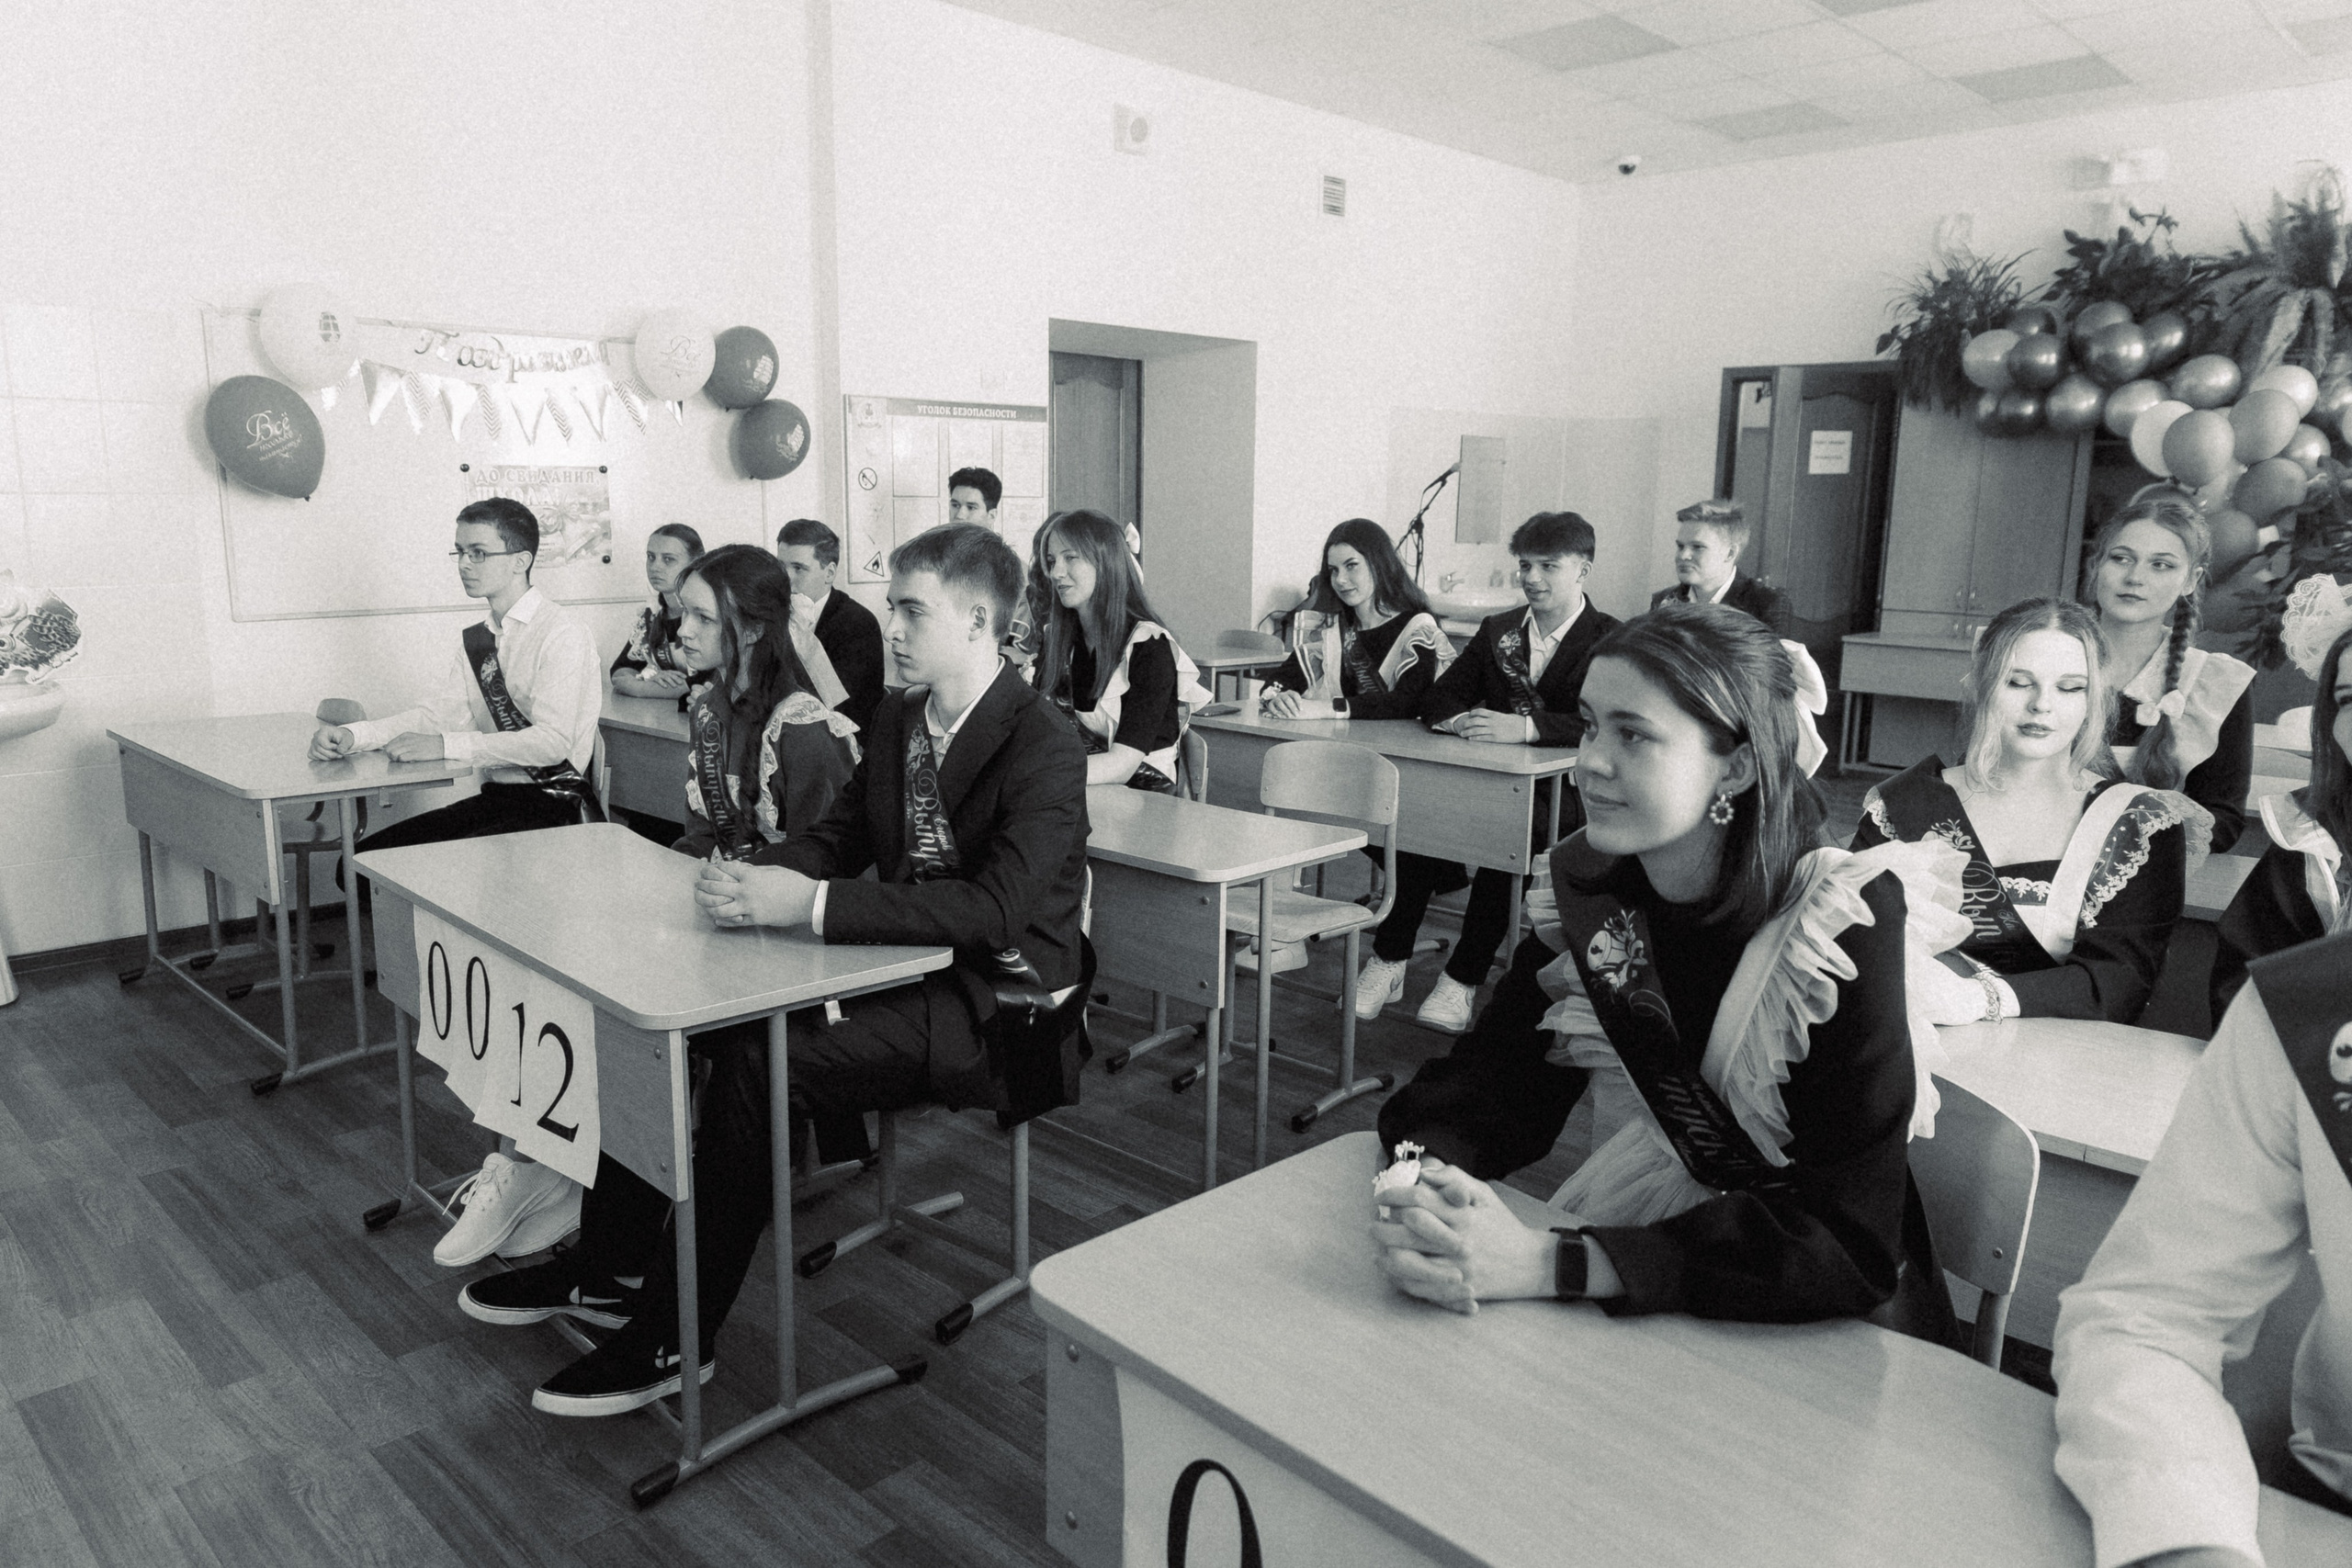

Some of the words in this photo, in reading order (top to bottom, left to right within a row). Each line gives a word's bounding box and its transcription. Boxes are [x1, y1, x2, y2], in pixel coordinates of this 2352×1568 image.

[917, 405, 951, 415] УГОЛОК
[953, 407, 1017, 419] БЕЗОПАСНОСТИ
[245, 410, 290, 449] Всё
[476, 469, 499, 485] ДО
[427, 941, 580, 1143] 0012
